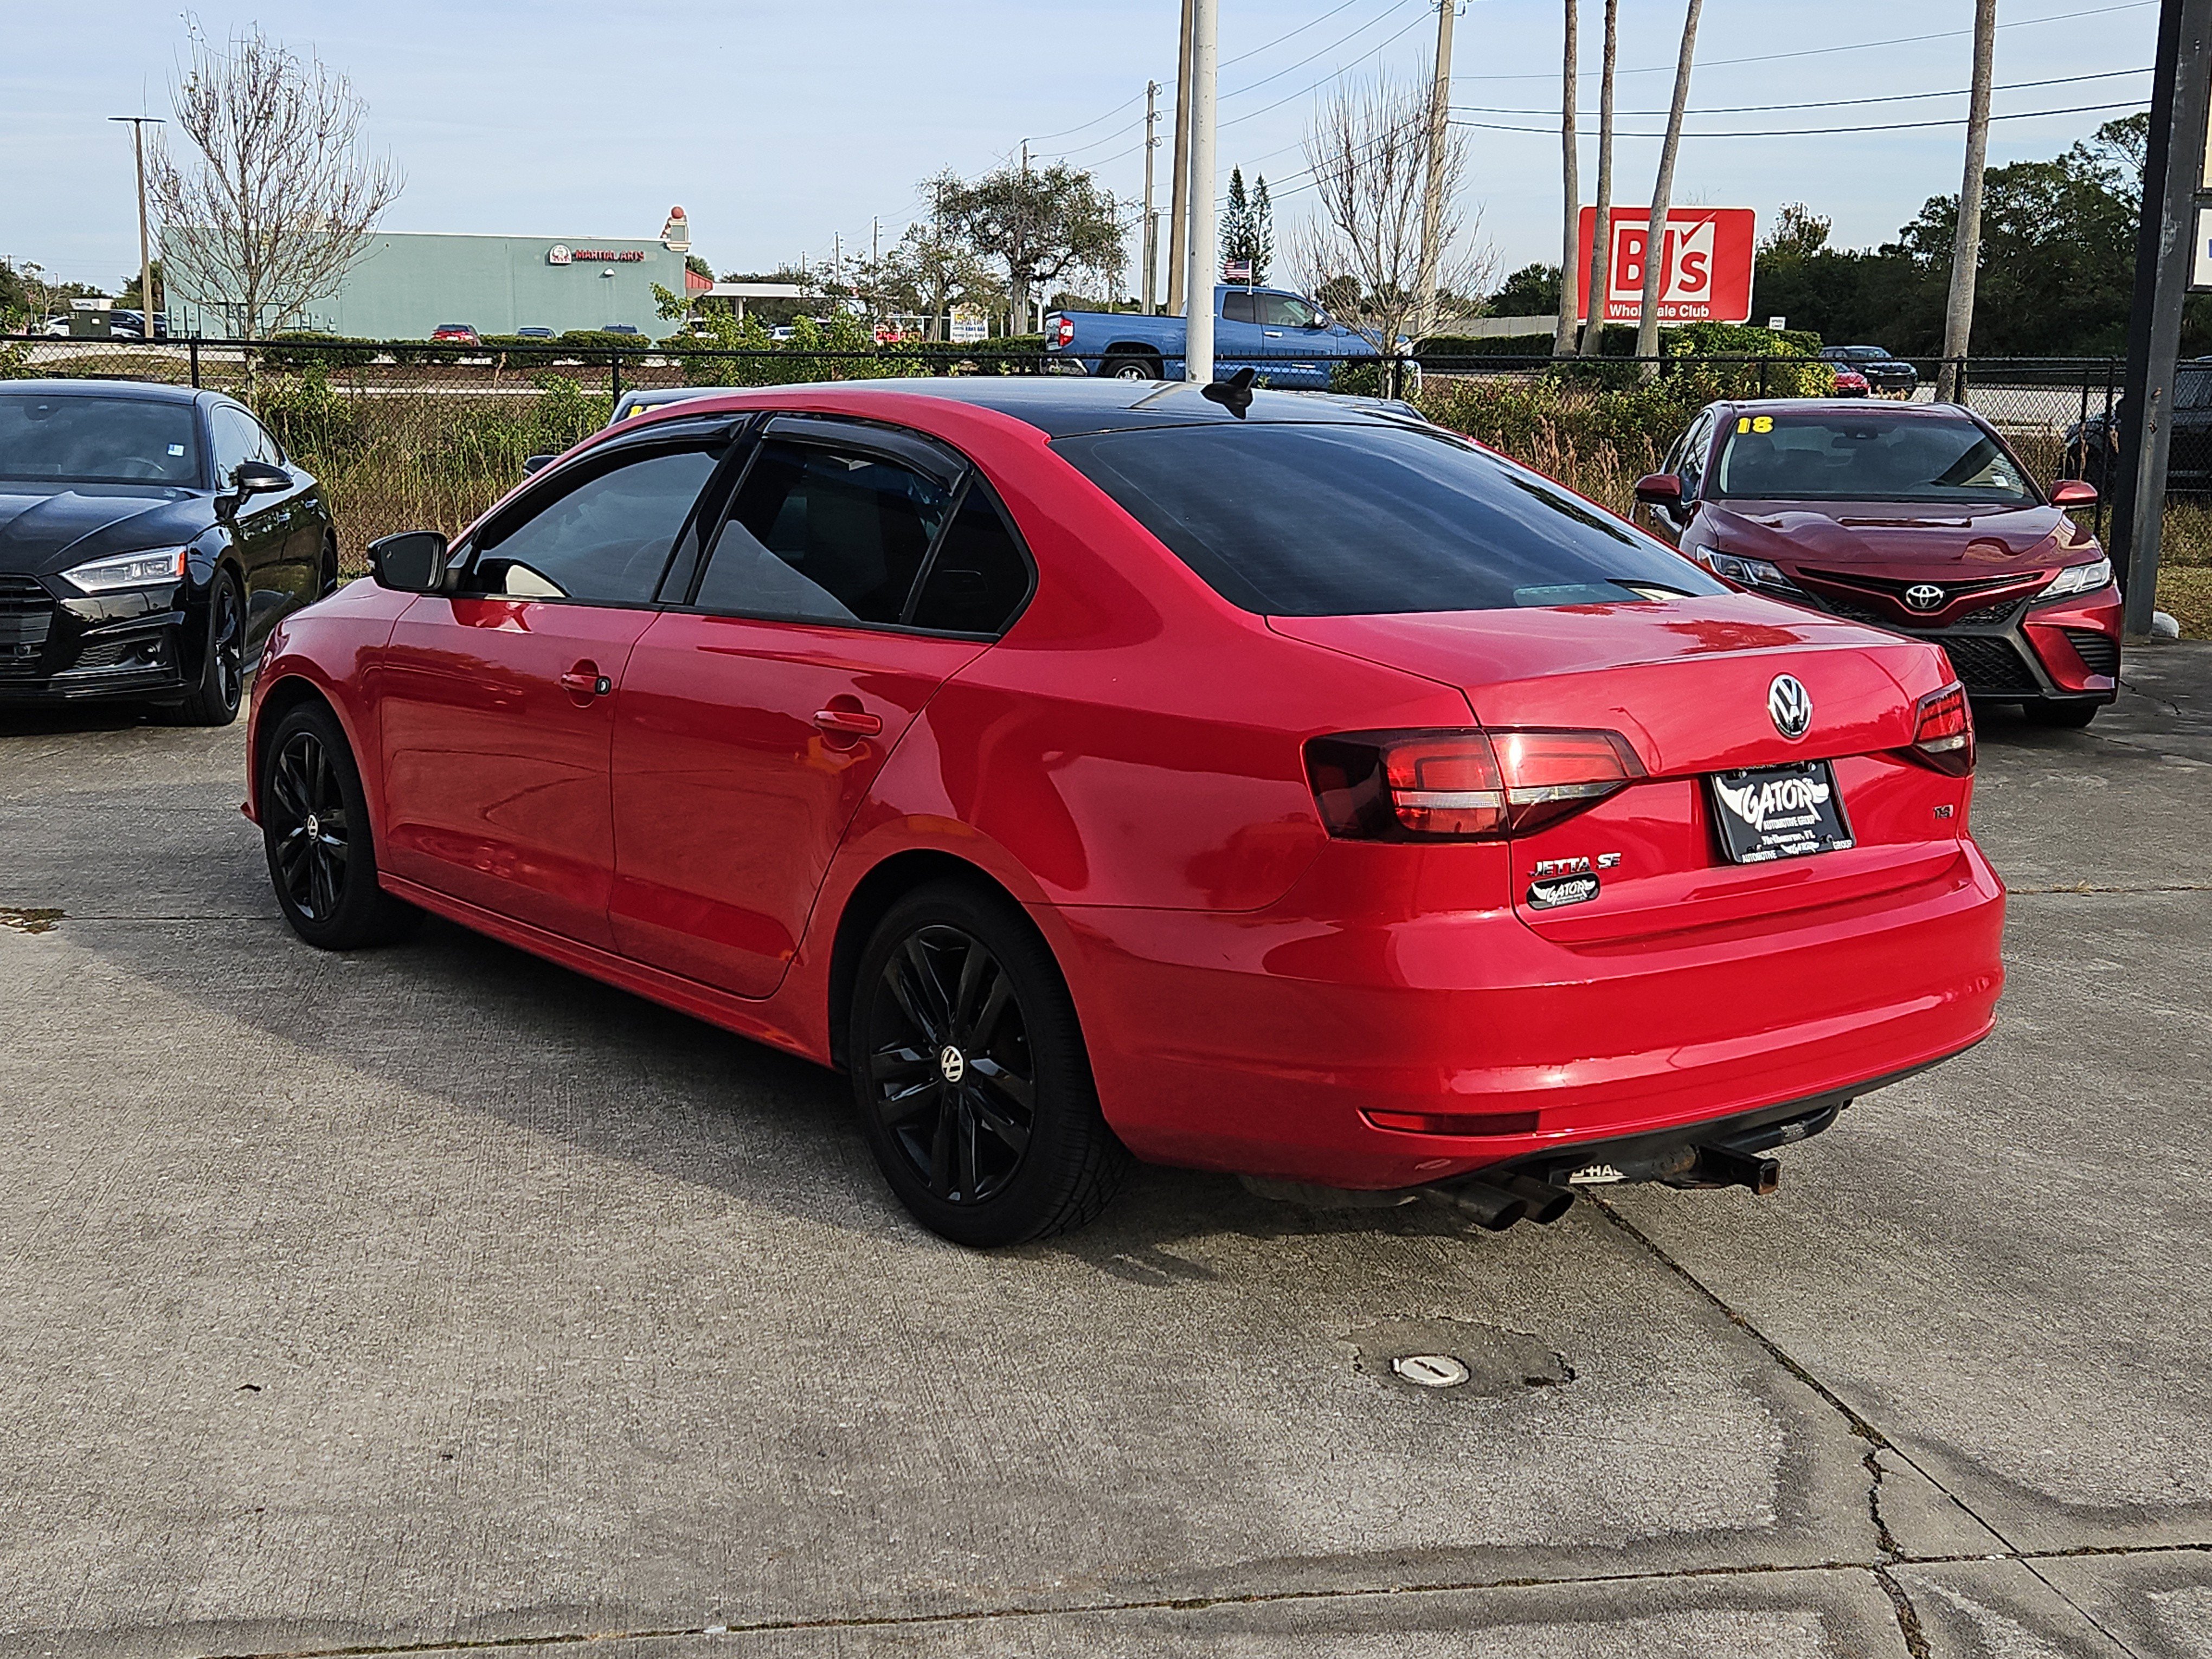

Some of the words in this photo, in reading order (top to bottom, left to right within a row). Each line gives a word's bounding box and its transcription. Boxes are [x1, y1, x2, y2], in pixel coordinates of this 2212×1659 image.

[576, 249, 618, 260] MARTIAL
[620, 250, 644, 261] ARTS
[1609, 304, 1676, 317] Wholale
[1679, 304, 1709, 318] Club
[1737, 416, 1773, 433] 18
[1742, 779, 1822, 832] GATOR
[1527, 857, 1591, 877] JETTA
[1597, 852, 1621, 869] SE
[1741, 850, 1777, 864] AUTOMOTIVE
[1546, 879, 1588, 905] GATOR
